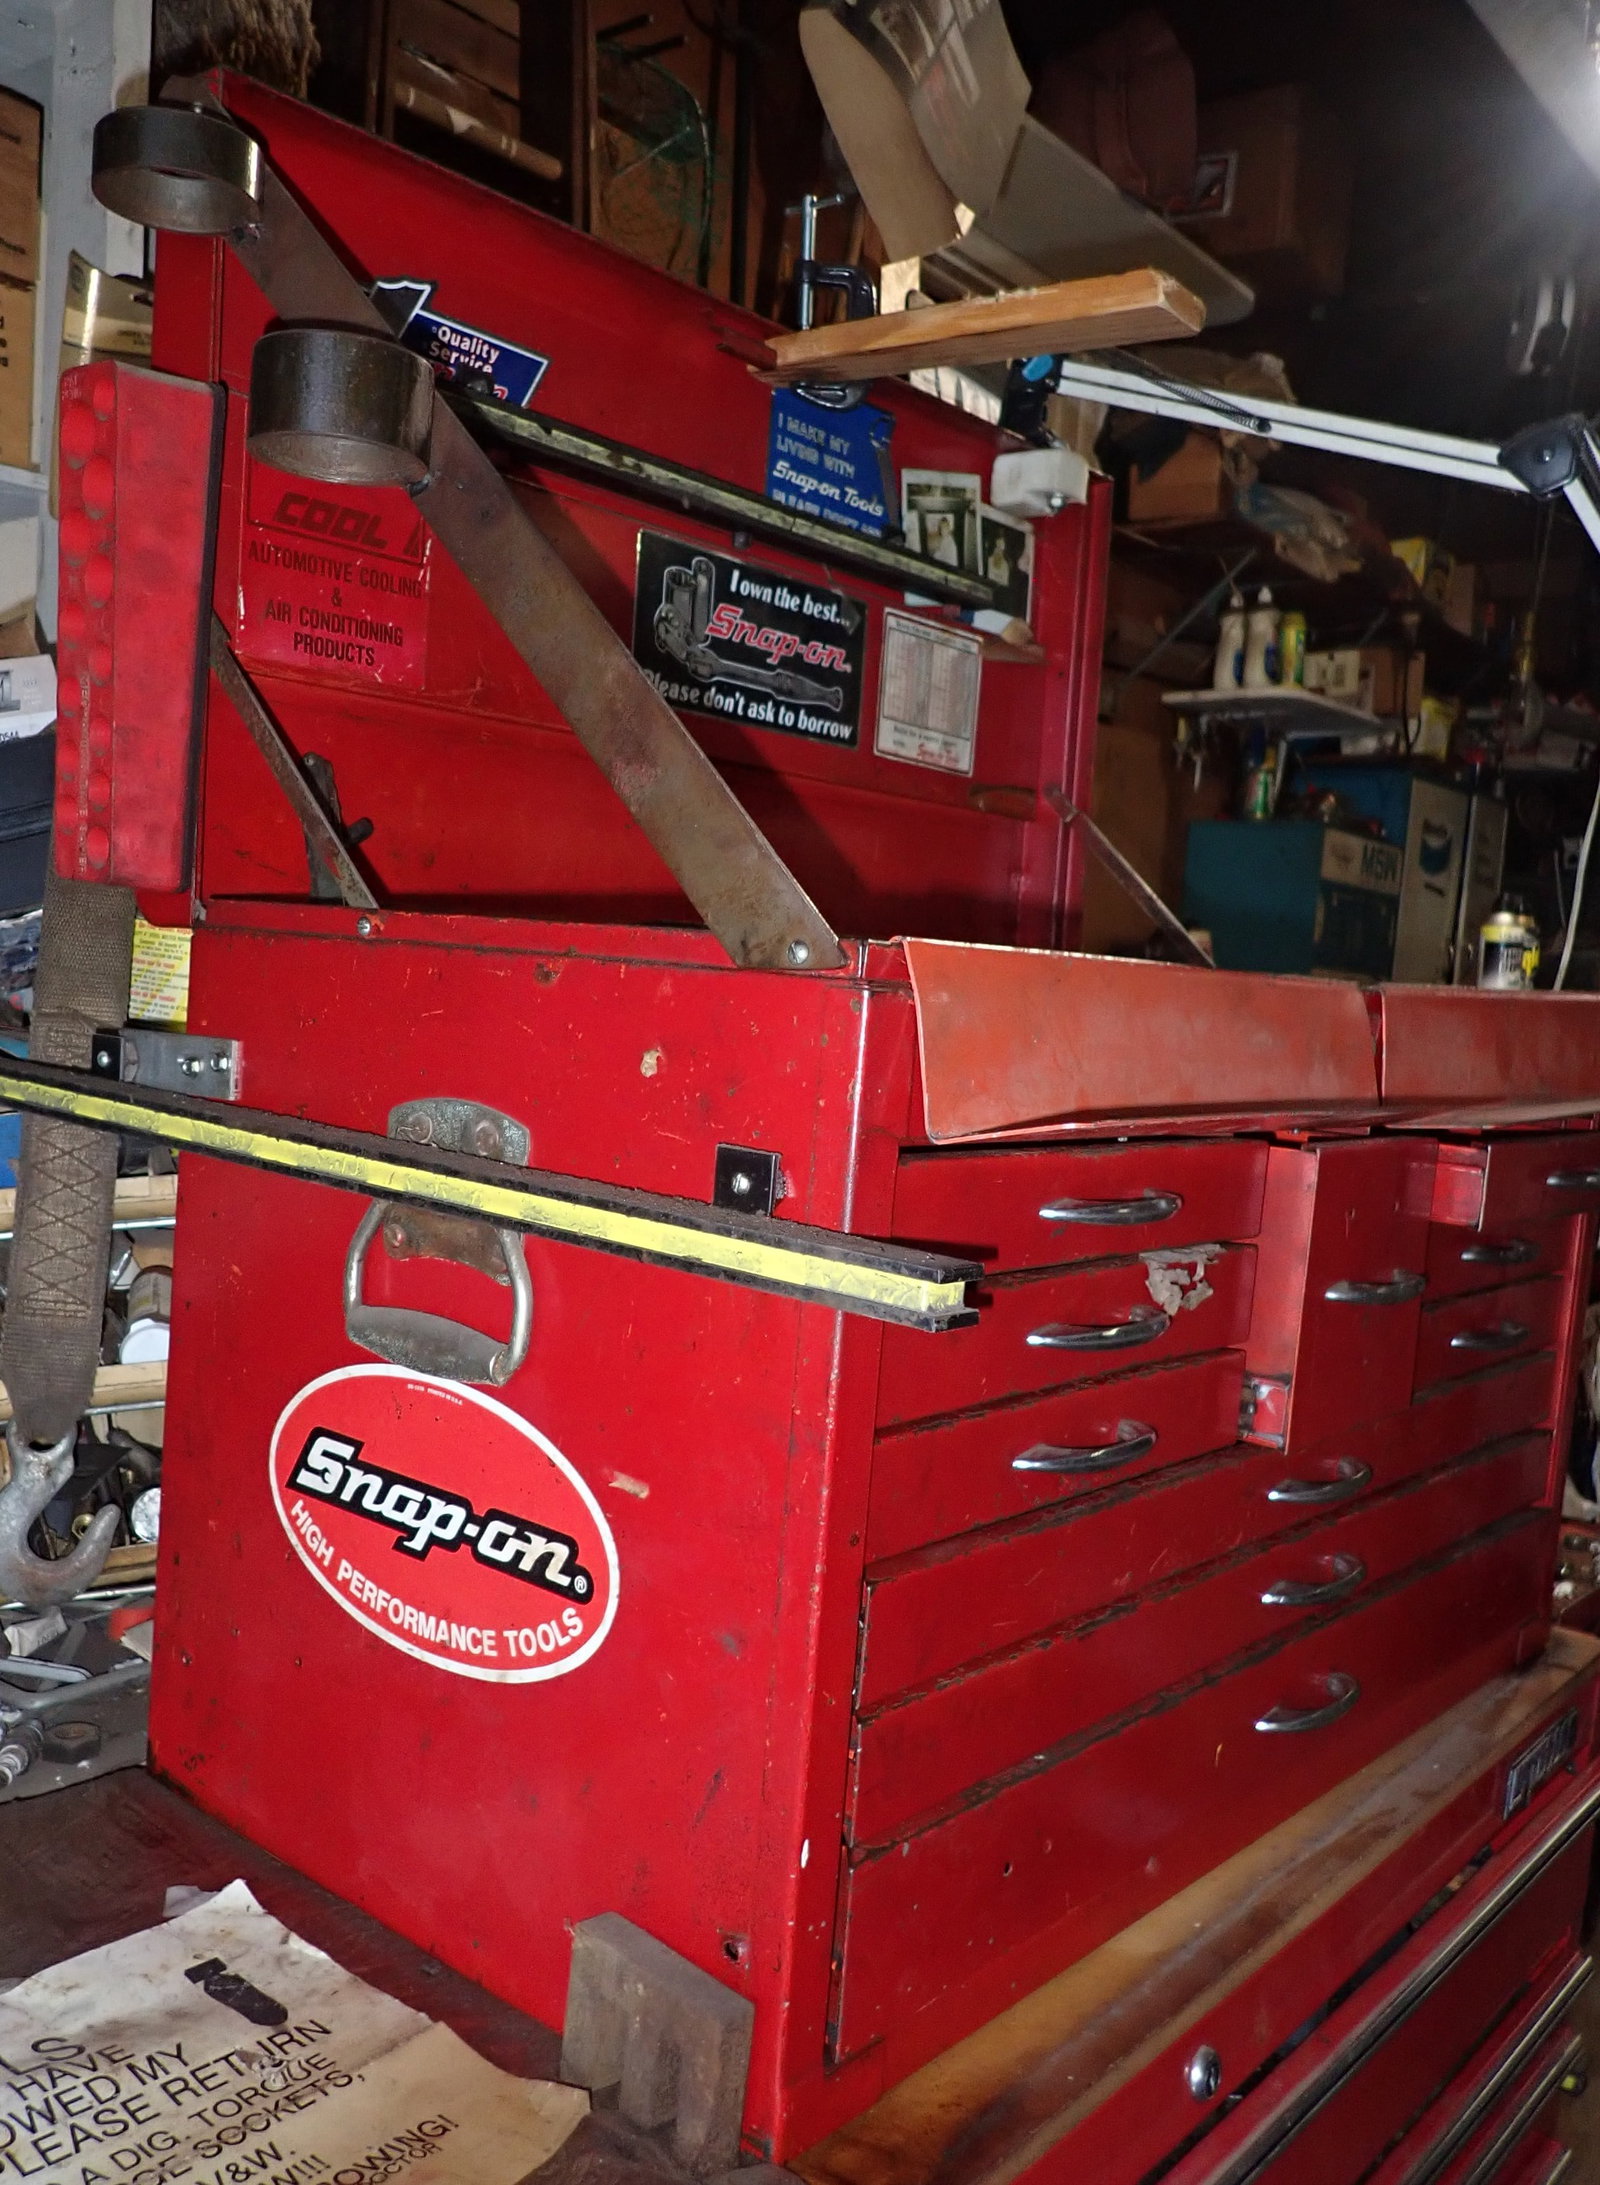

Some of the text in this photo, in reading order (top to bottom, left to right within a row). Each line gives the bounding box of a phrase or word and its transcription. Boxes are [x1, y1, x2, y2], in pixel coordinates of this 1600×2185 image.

[436, 325, 501, 365] Quality
[786, 416, 827, 446] MAKE
[828, 433, 851, 456] MY
[772, 460, 841, 501] Snap-on
[843, 486, 884, 517] Tools
[823, 454, 856, 479] WITH
[273, 491, 389, 549] COOL
[249, 540, 422, 599] AUTOMOTIVE COOLING
[730, 568, 740, 592] I
[740, 579, 773, 600] own
[773, 585, 800, 612] the
[331, 587, 343, 607] &
[265, 599, 403, 647] AIR CONDITIONING
[293, 632, 375, 667] PRODUCTS
[703, 685, 745, 716] don't
[747, 701, 775, 723] ask
[778, 704, 796, 727] to
[797, 707, 852, 740] borrow
[296, 1436, 572, 1588] Snap-on
[290, 1500, 585, 1657] HIGH PERFORMANCE TOOLS
[7, 2044, 136, 2101] HAVE
[126, 2042, 190, 2086] MY
[0, 2093, 161, 2178] LEASE
[193, 2069, 366, 2159] SOCKETS,
[109, 2130, 191, 2171] DIG.
[316, 2114, 460, 2185] OWING!
[358, 2142, 443, 2185] OCTOR
